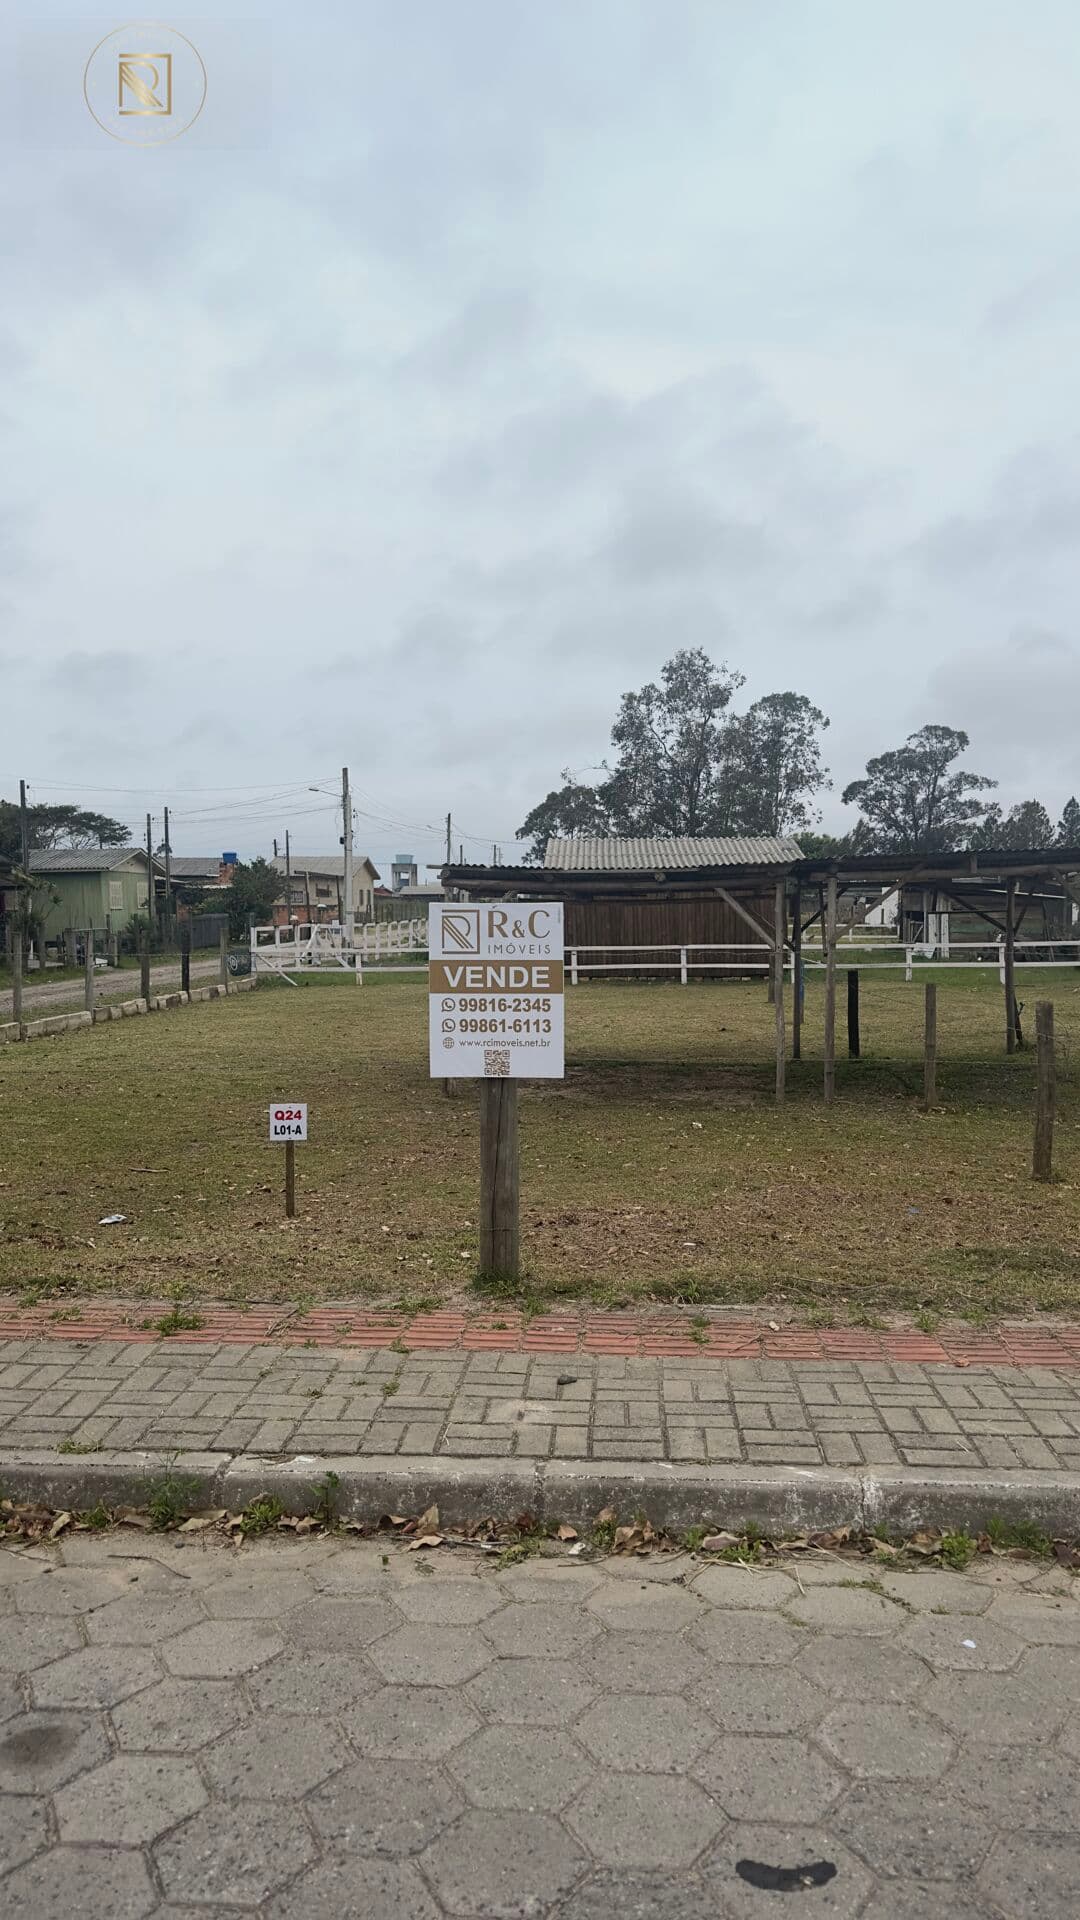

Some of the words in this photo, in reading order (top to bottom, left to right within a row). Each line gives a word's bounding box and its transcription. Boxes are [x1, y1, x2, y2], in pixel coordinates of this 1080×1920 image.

[487, 910, 551, 939] R&C
[488, 943, 551, 955] IMÓVEIS
[443, 966, 550, 988] VENDE
[459, 998, 551, 1012] 99816-2345
[459, 1018, 552, 1033] 99861-6113
[459, 1038, 551, 1048] www.rcimoveis.net.br
[274, 1110, 302, 1121] Q24
[274, 1124, 302, 1136] L01-A
